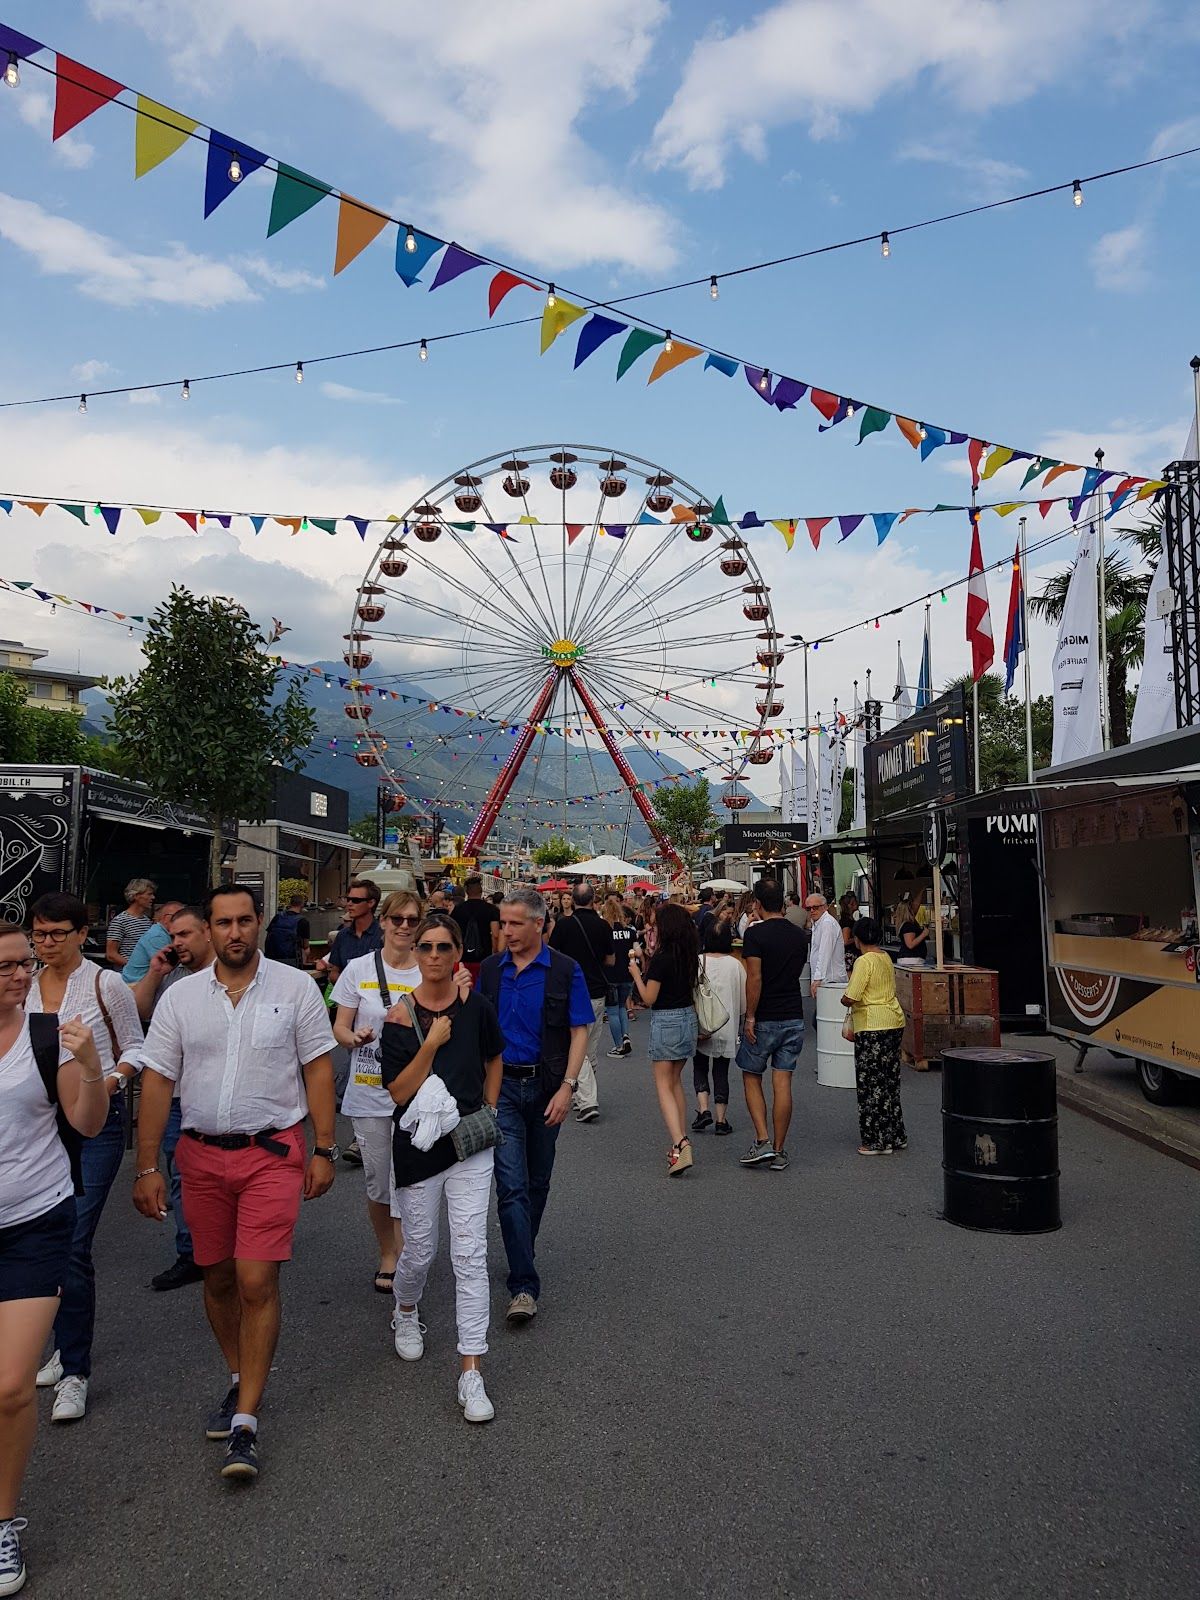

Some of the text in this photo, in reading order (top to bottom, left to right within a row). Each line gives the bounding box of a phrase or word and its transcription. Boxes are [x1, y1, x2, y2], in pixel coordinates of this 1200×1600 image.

[877, 743, 903, 785] POMMES
[742, 829, 792, 838] Moon&Stars
[612, 930, 631, 940] REW
[1074, 979, 1099, 998] DESSERTS
